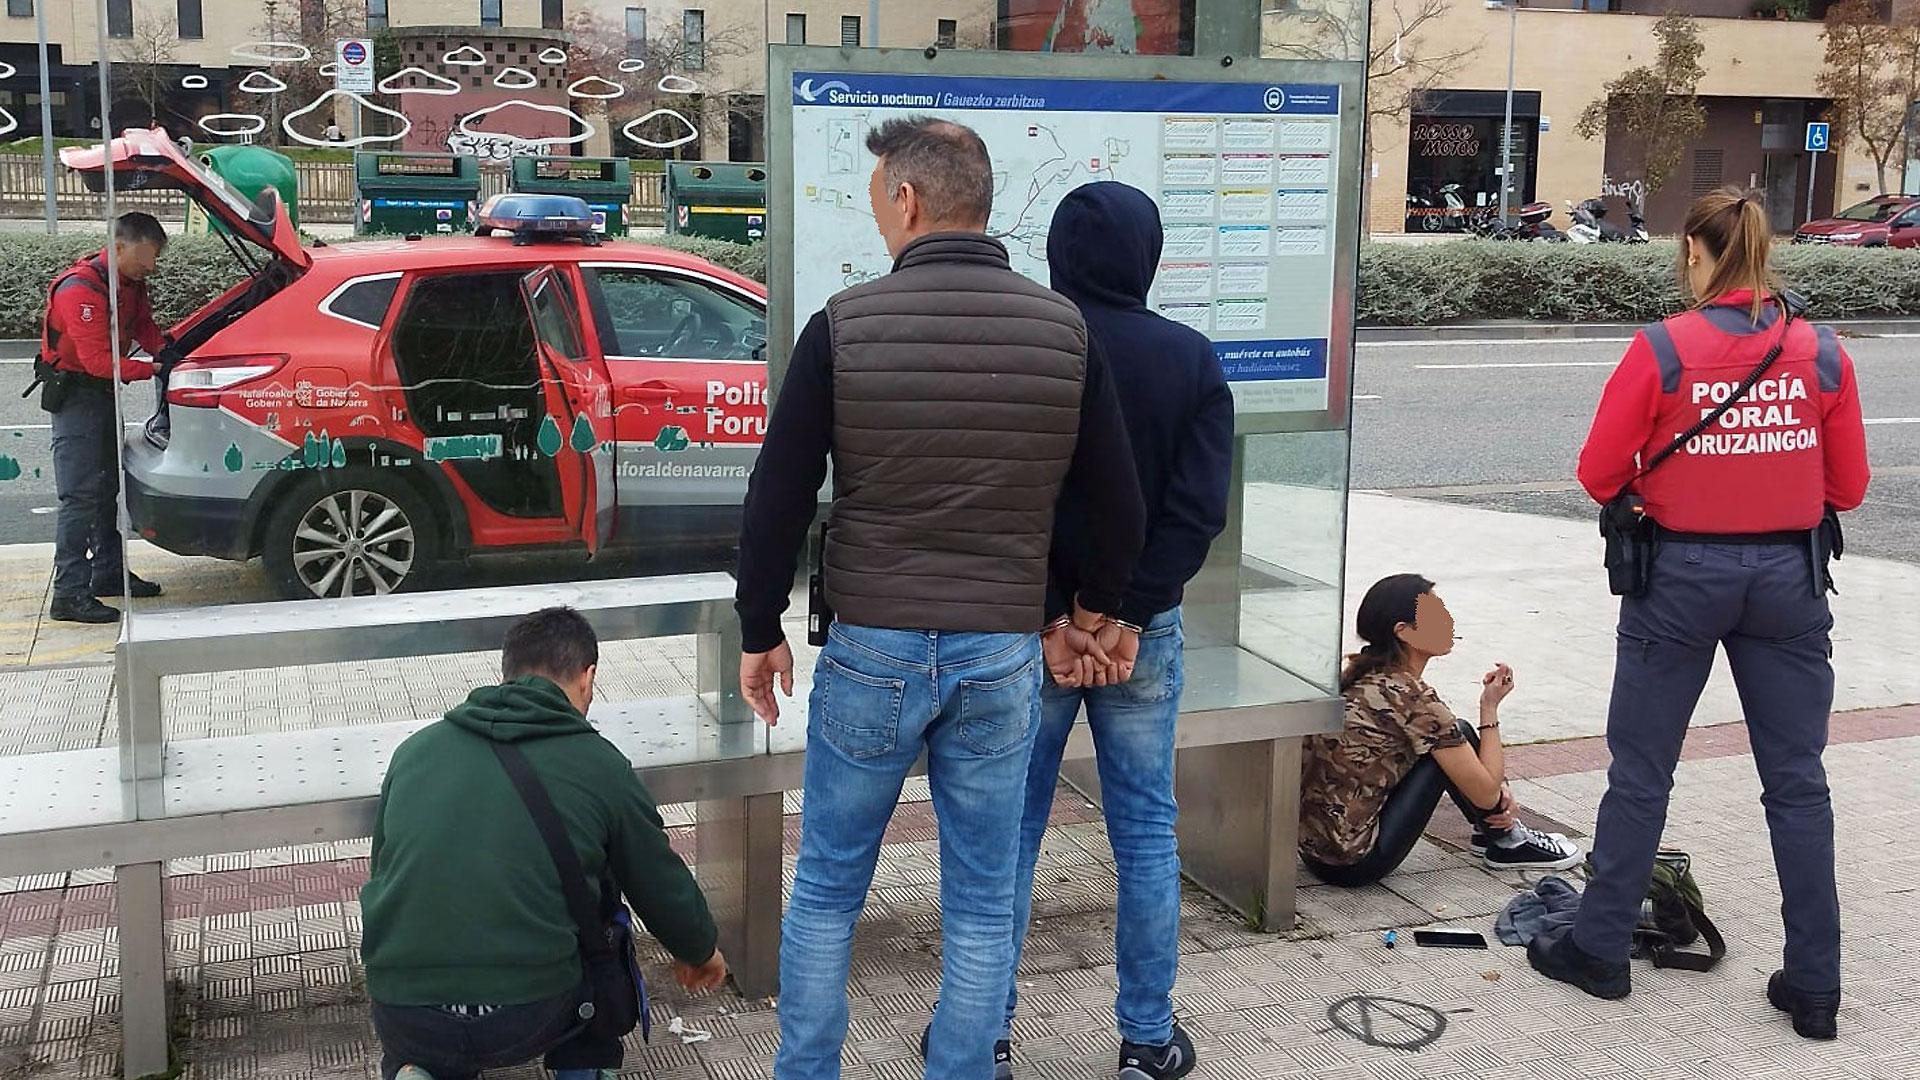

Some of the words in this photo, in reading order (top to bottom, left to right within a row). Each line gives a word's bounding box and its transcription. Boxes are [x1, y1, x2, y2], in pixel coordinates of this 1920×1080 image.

[829, 90, 879, 104] Servicio
[881, 93, 933, 106] nocturno
[944, 92, 993, 107] Gauezko
[1414, 124, 1475, 140] ROSSO
[1421, 140, 1480, 156] MOTOS
[1674, 427, 1818, 455] ORUZAINGOA
